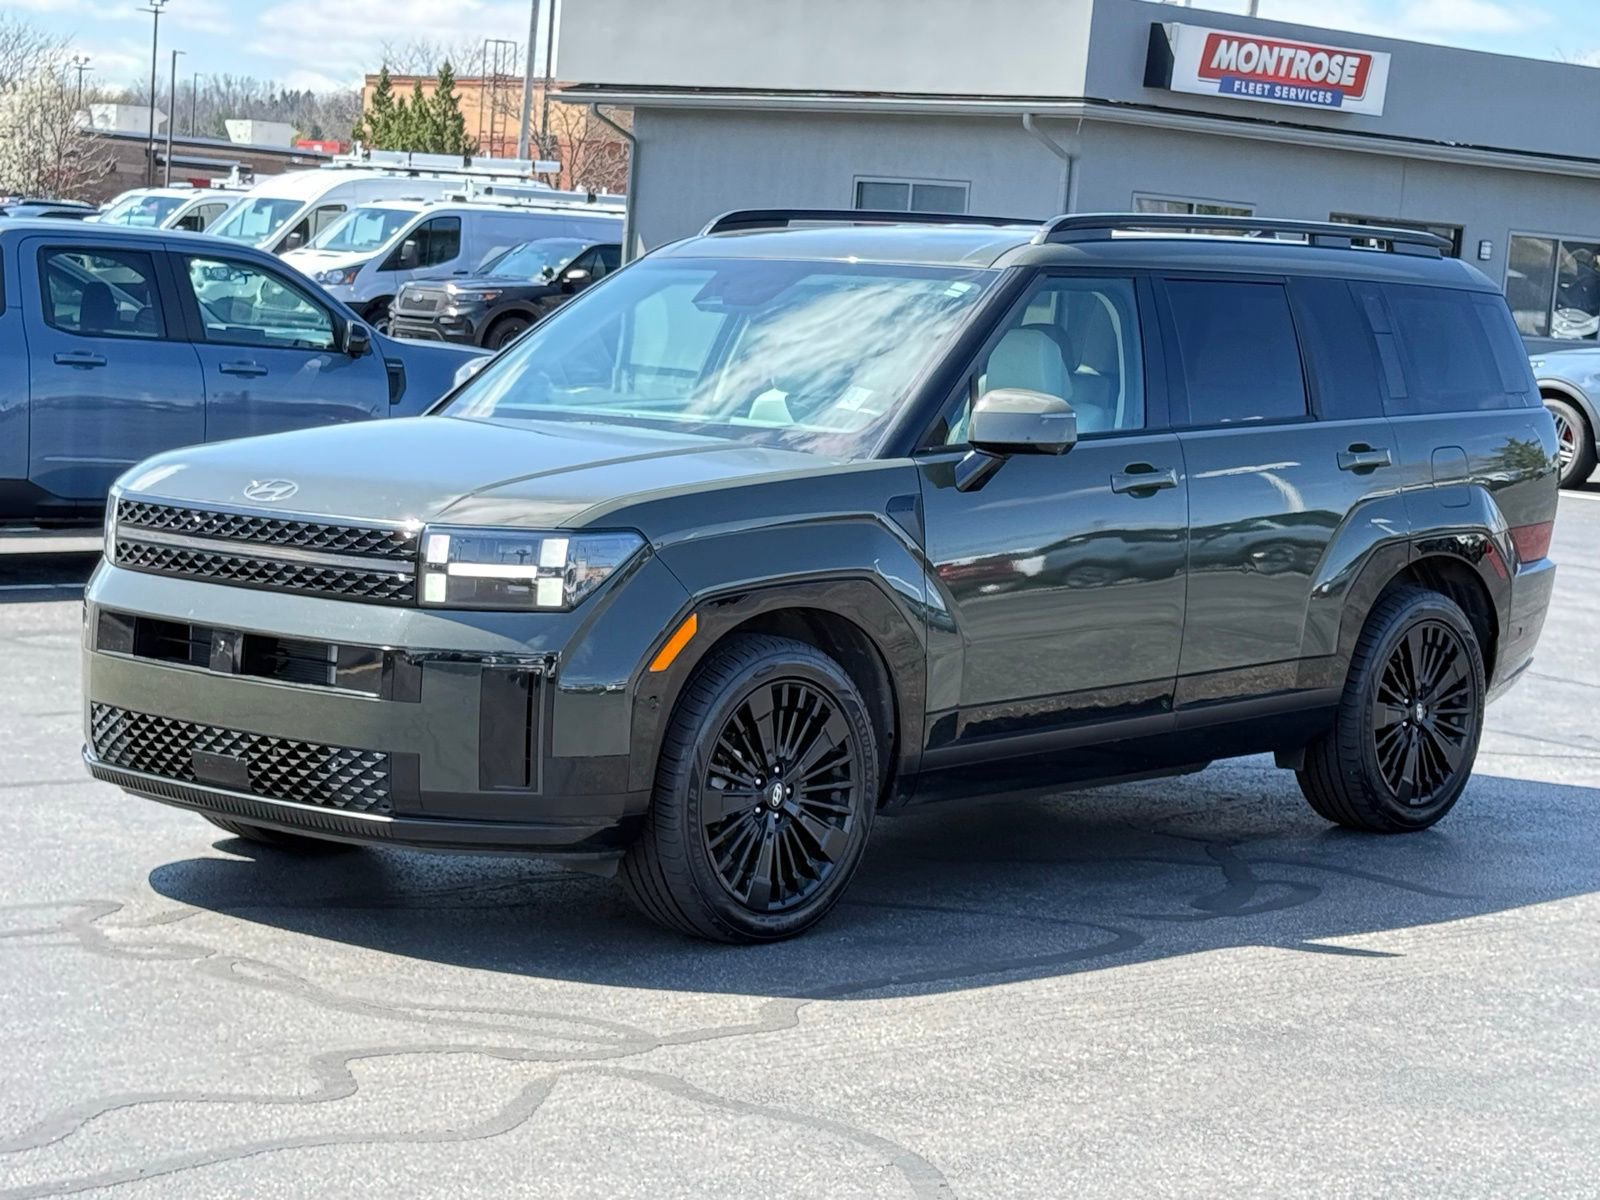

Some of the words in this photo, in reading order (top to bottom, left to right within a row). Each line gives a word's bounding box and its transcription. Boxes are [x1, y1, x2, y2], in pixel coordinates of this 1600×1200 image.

[1210, 39, 1360, 87] MONTROSE
[1233, 80, 1271, 96] FLEET
[1274, 85, 1333, 104] SERVICES
